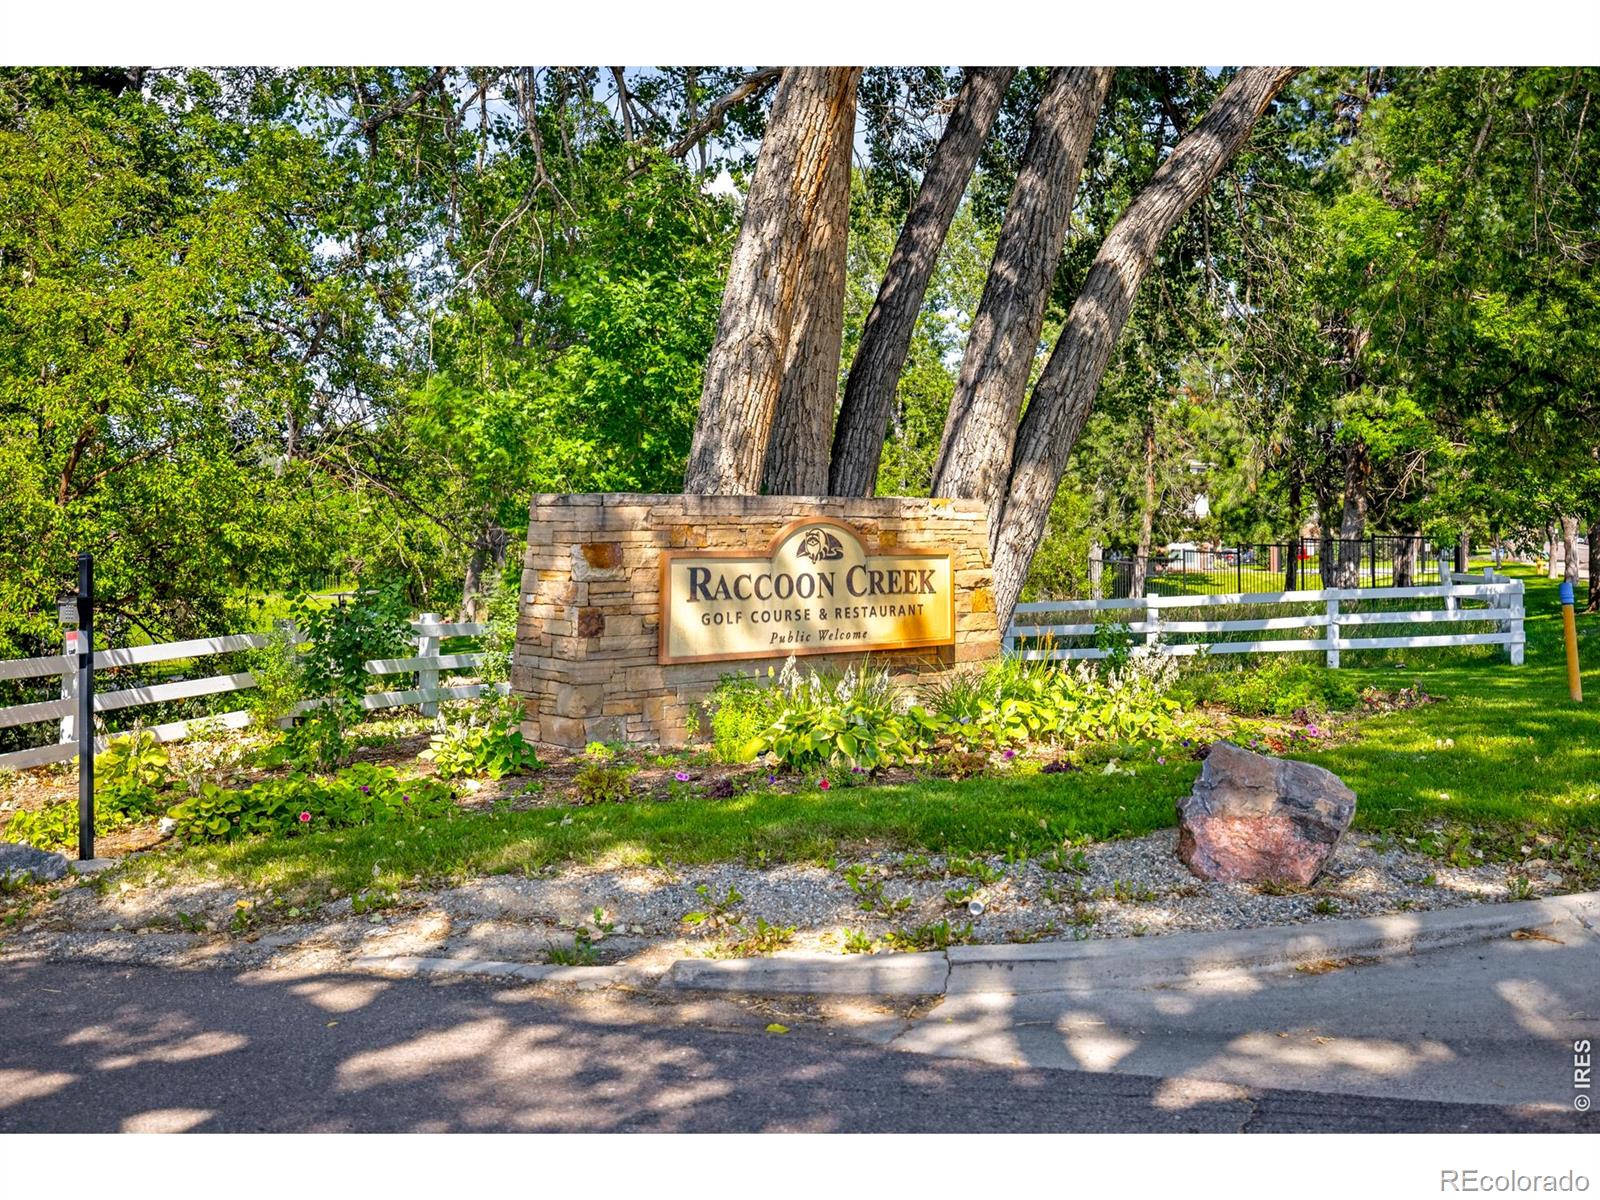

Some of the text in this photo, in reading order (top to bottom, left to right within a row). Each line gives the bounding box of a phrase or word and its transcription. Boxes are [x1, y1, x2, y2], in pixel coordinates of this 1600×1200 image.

[686, 565, 936, 602] RACCOON CREEK
[701, 604, 924, 626] GOLF COURSE & RESTAURANT
[770, 629, 869, 644] Public Welcome
